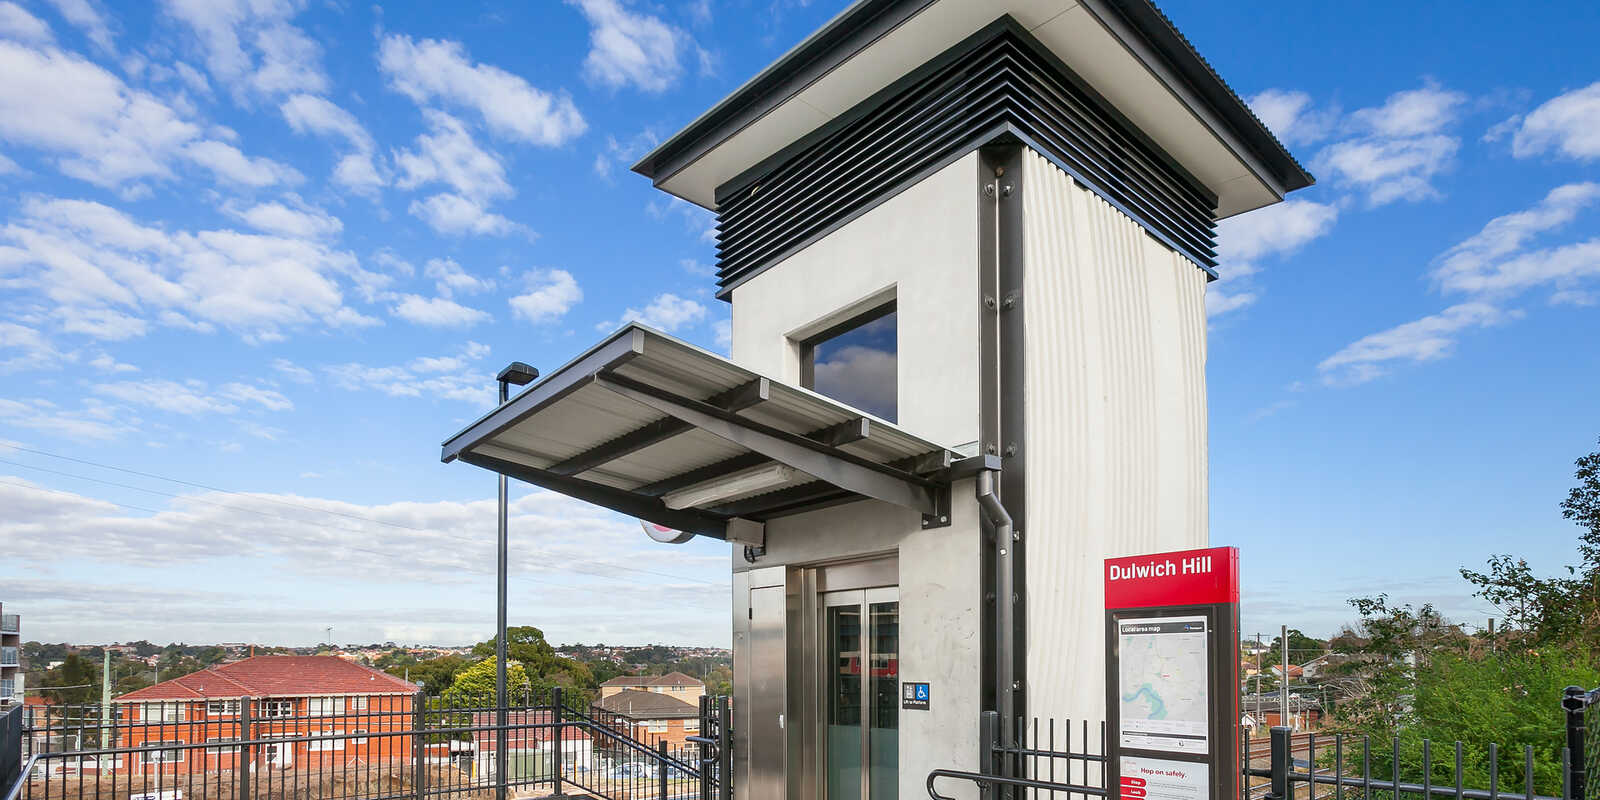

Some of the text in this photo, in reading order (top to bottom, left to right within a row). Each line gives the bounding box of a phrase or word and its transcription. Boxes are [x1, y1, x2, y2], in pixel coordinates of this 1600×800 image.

[1110, 556, 1212, 581] Dulwich Hill
[1141, 767, 1154, 775] Hop
